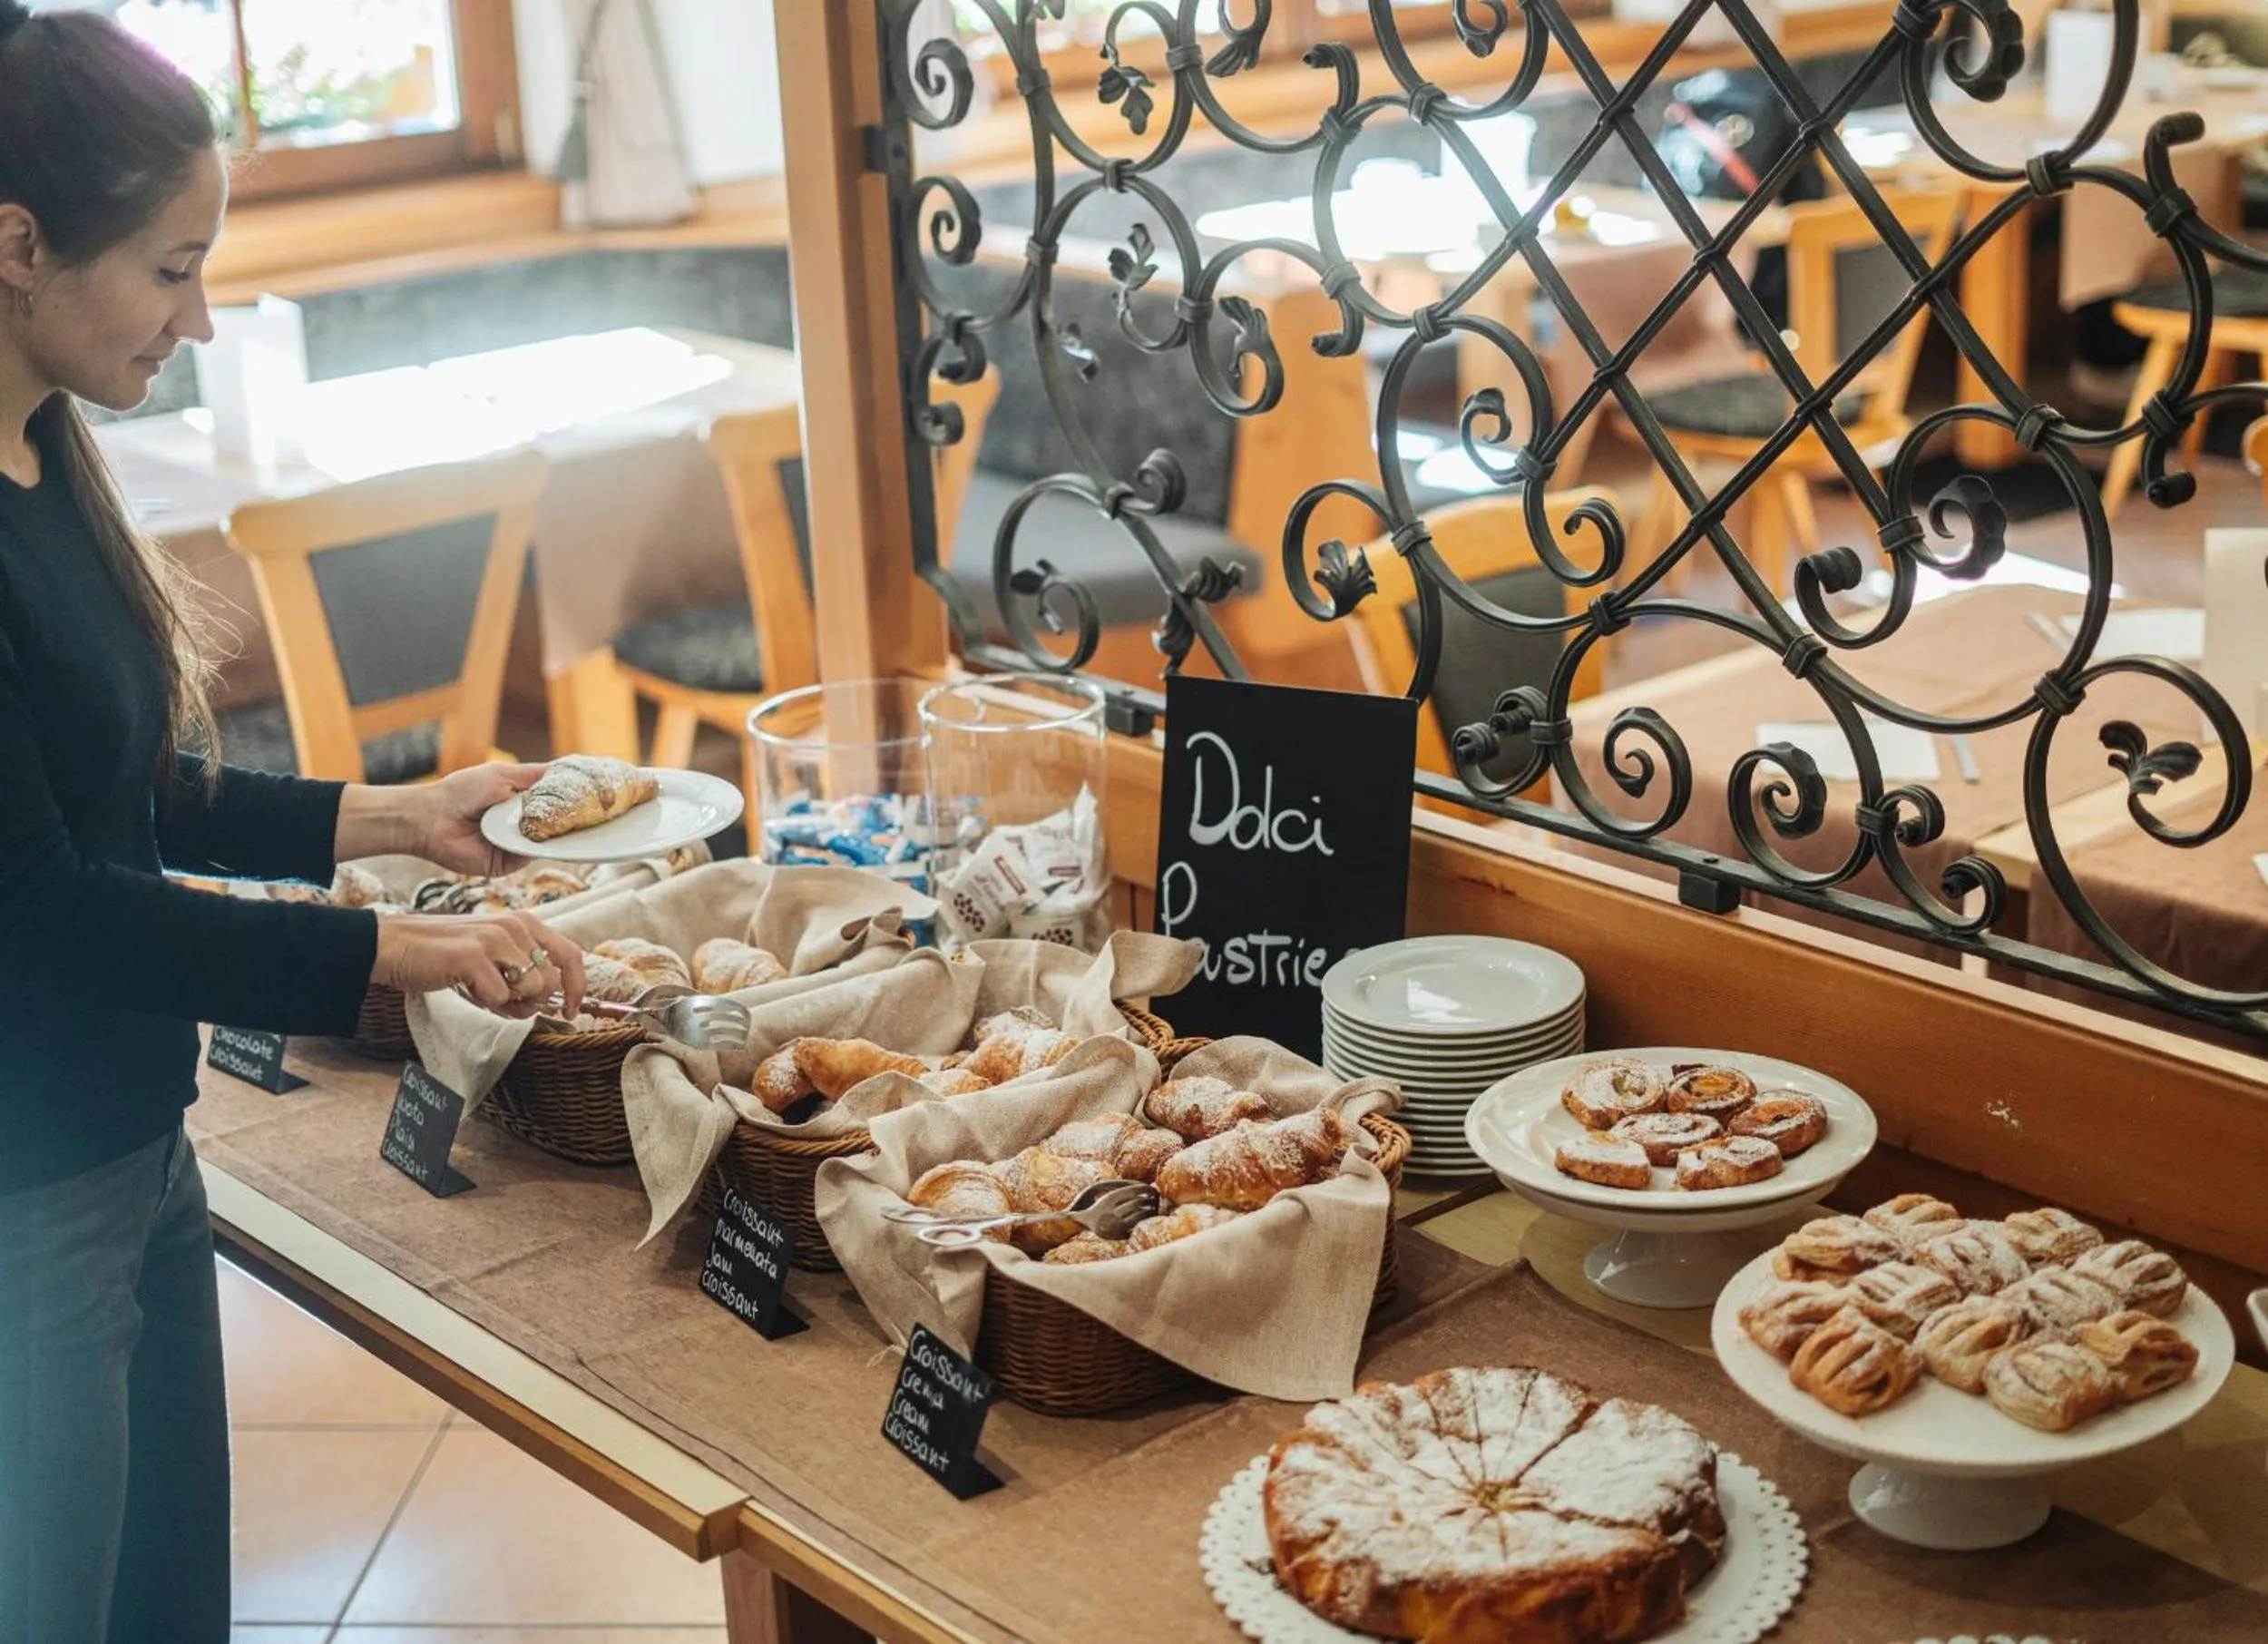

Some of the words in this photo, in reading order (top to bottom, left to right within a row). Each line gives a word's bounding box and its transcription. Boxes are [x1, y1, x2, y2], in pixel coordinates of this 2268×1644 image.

[1186, 730, 1334, 856] Dolci
[1162, 861, 1362, 988] Pastrie
[893, 1388, 931, 1434] Cream
[901, 1366, 944, 1410] Crema
